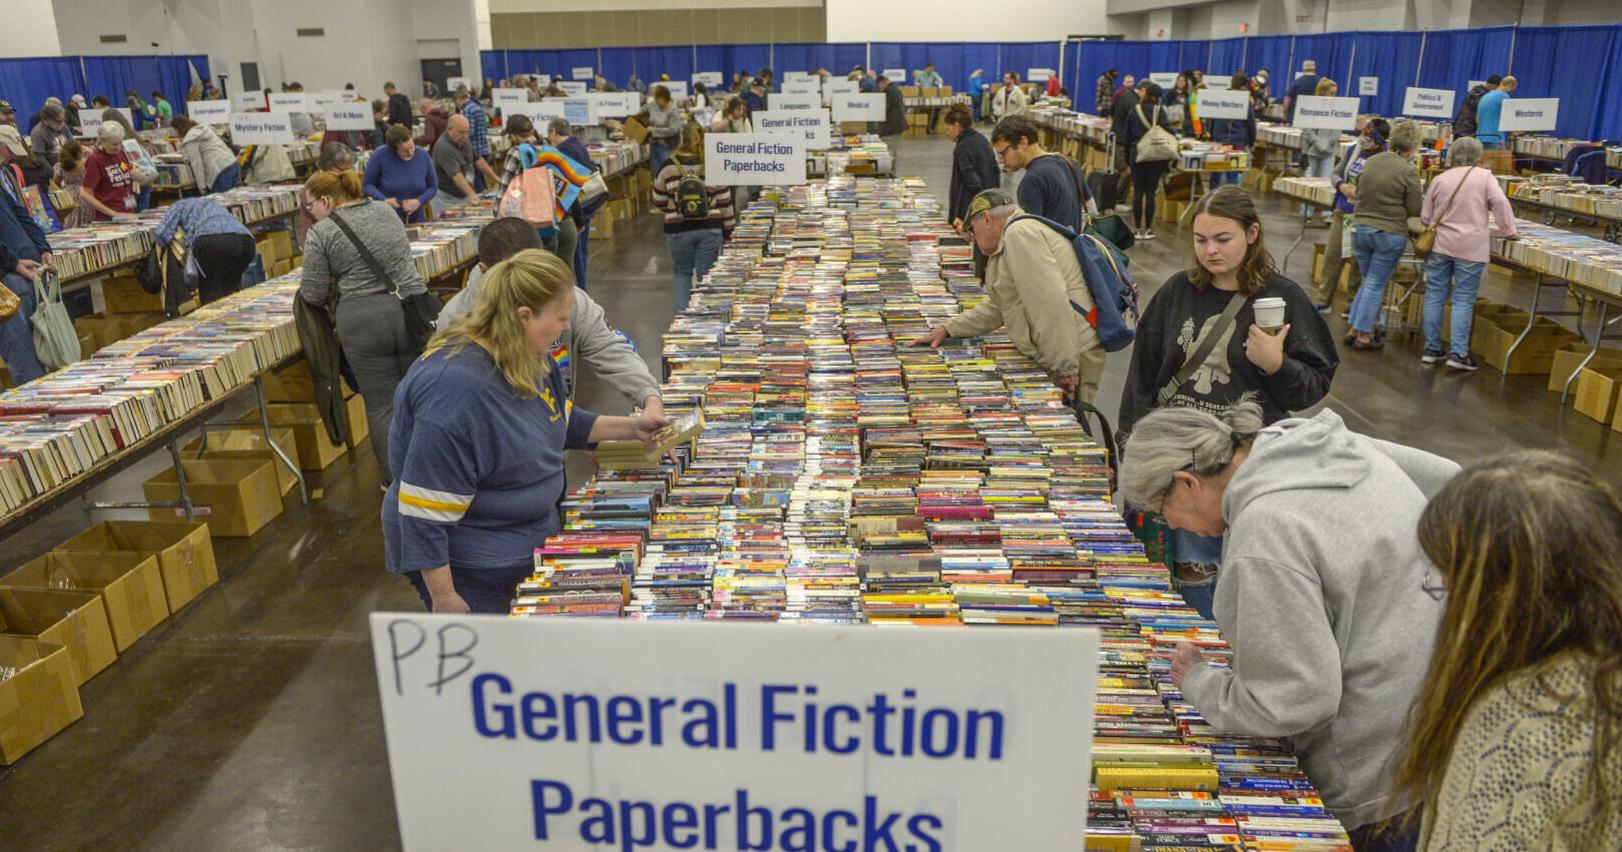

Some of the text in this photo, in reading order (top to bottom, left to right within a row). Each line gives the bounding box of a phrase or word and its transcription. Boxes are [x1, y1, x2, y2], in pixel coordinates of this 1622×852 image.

[1202, 100, 1243, 109] Money Matters
[1413, 102, 1444, 110] Government
[194, 108, 225, 116] Entertainment
[1300, 108, 1352, 118] Romance Fiction
[1515, 110, 1543, 118] Westerns
[83, 118, 101, 127] Crafts
[762, 117, 821, 128] General Fiction
[235, 123, 286, 133] Mystery Fiction
[716, 141, 793, 155] General Fiction
[724, 159, 785, 173] Paperbacks
[471, 672, 1004, 761] General Fiction
[530, 779, 943, 852] Paperbacks
